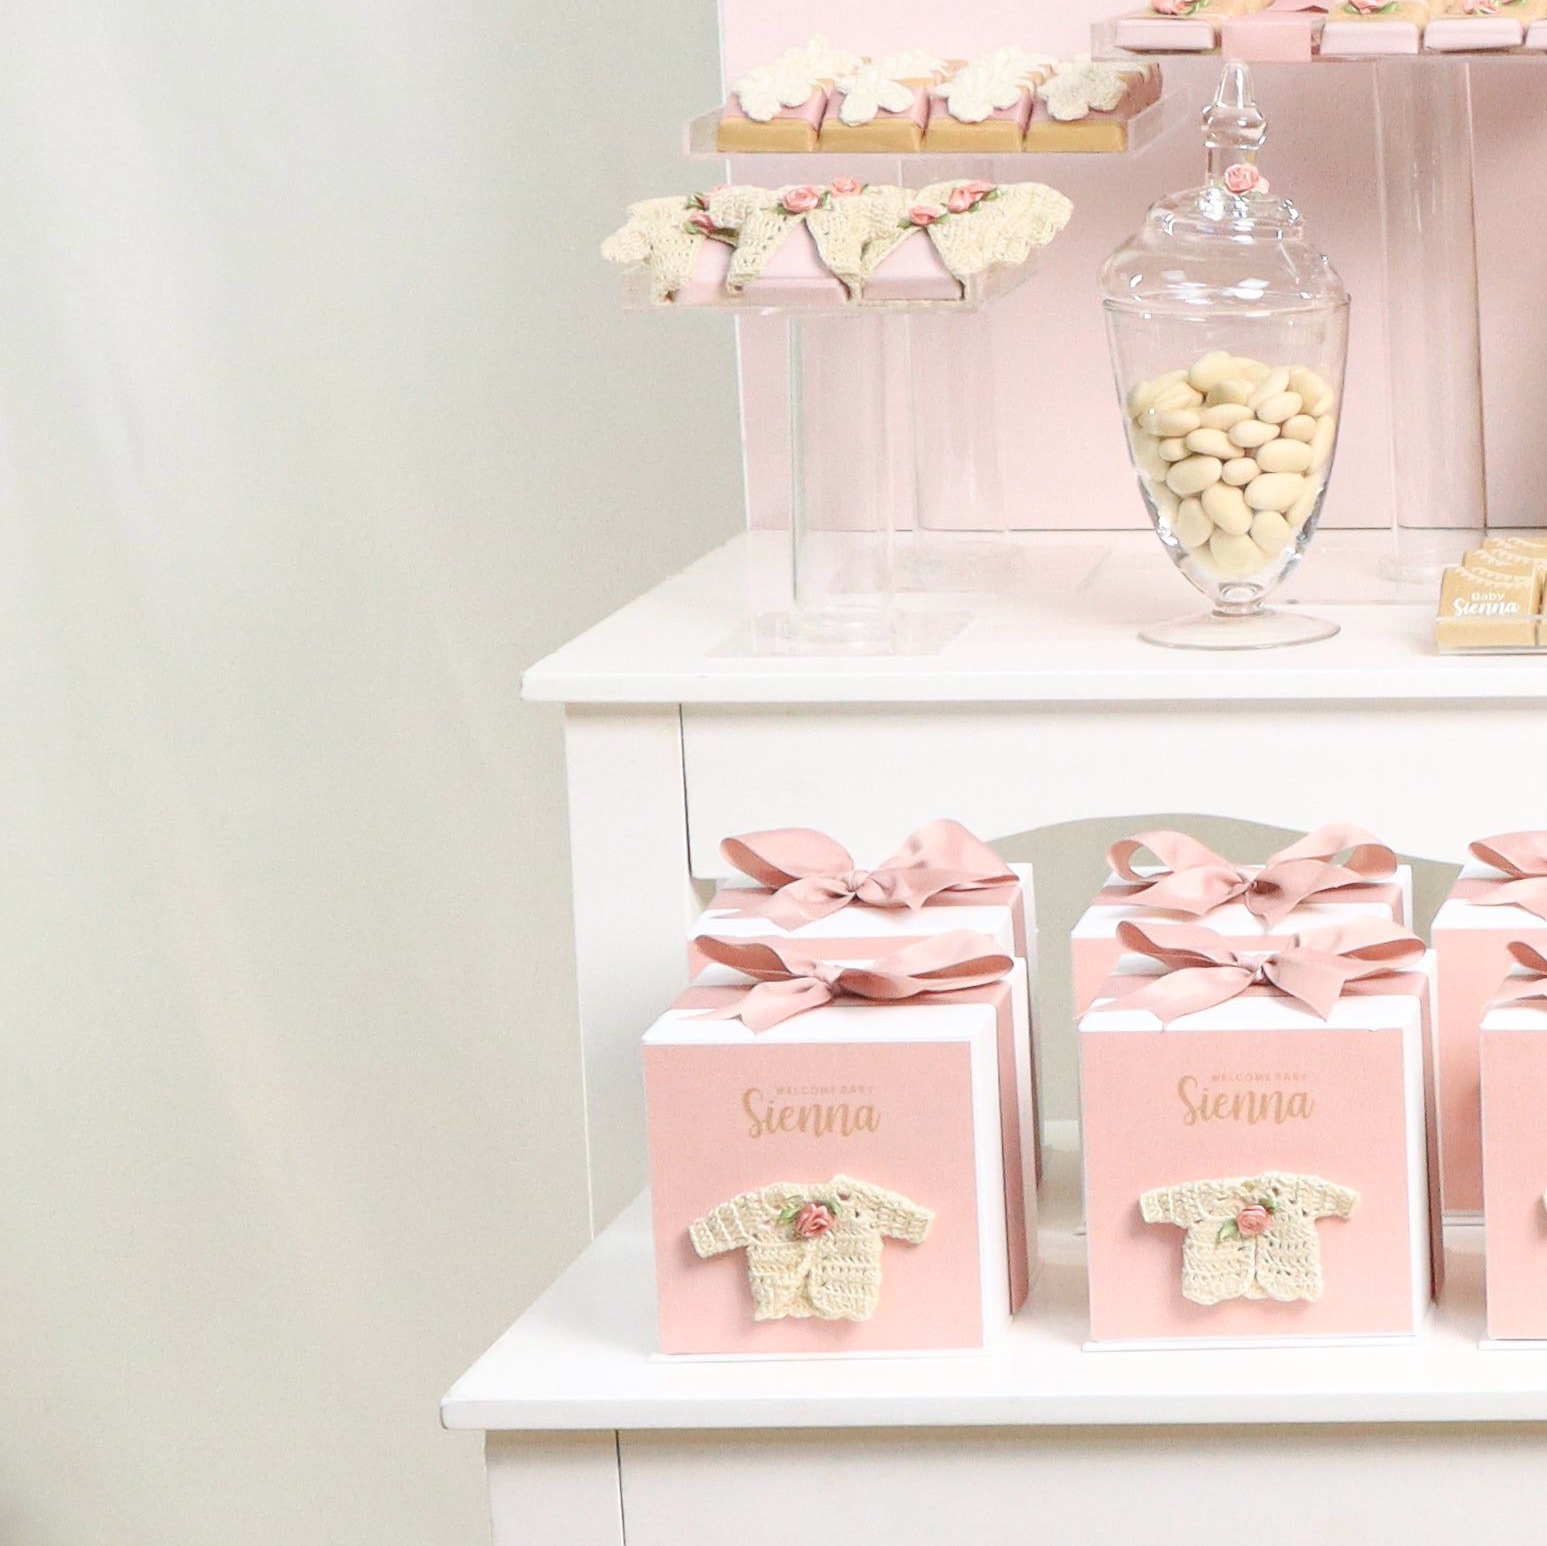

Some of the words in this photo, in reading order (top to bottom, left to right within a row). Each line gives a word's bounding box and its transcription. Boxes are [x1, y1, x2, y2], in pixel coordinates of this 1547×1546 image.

[1471, 592, 1505, 604] Baby
[1453, 597, 1519, 615] Sienna
[1210, 1073, 1272, 1082] WELCOME
[1275, 1072, 1308, 1082] BABY
[775, 1085, 836, 1095] WELCOME
[840, 1085, 874, 1094] BABY
[1177, 1075, 1315, 1127] Sienna
[742, 1087, 881, 1139] Sienna
